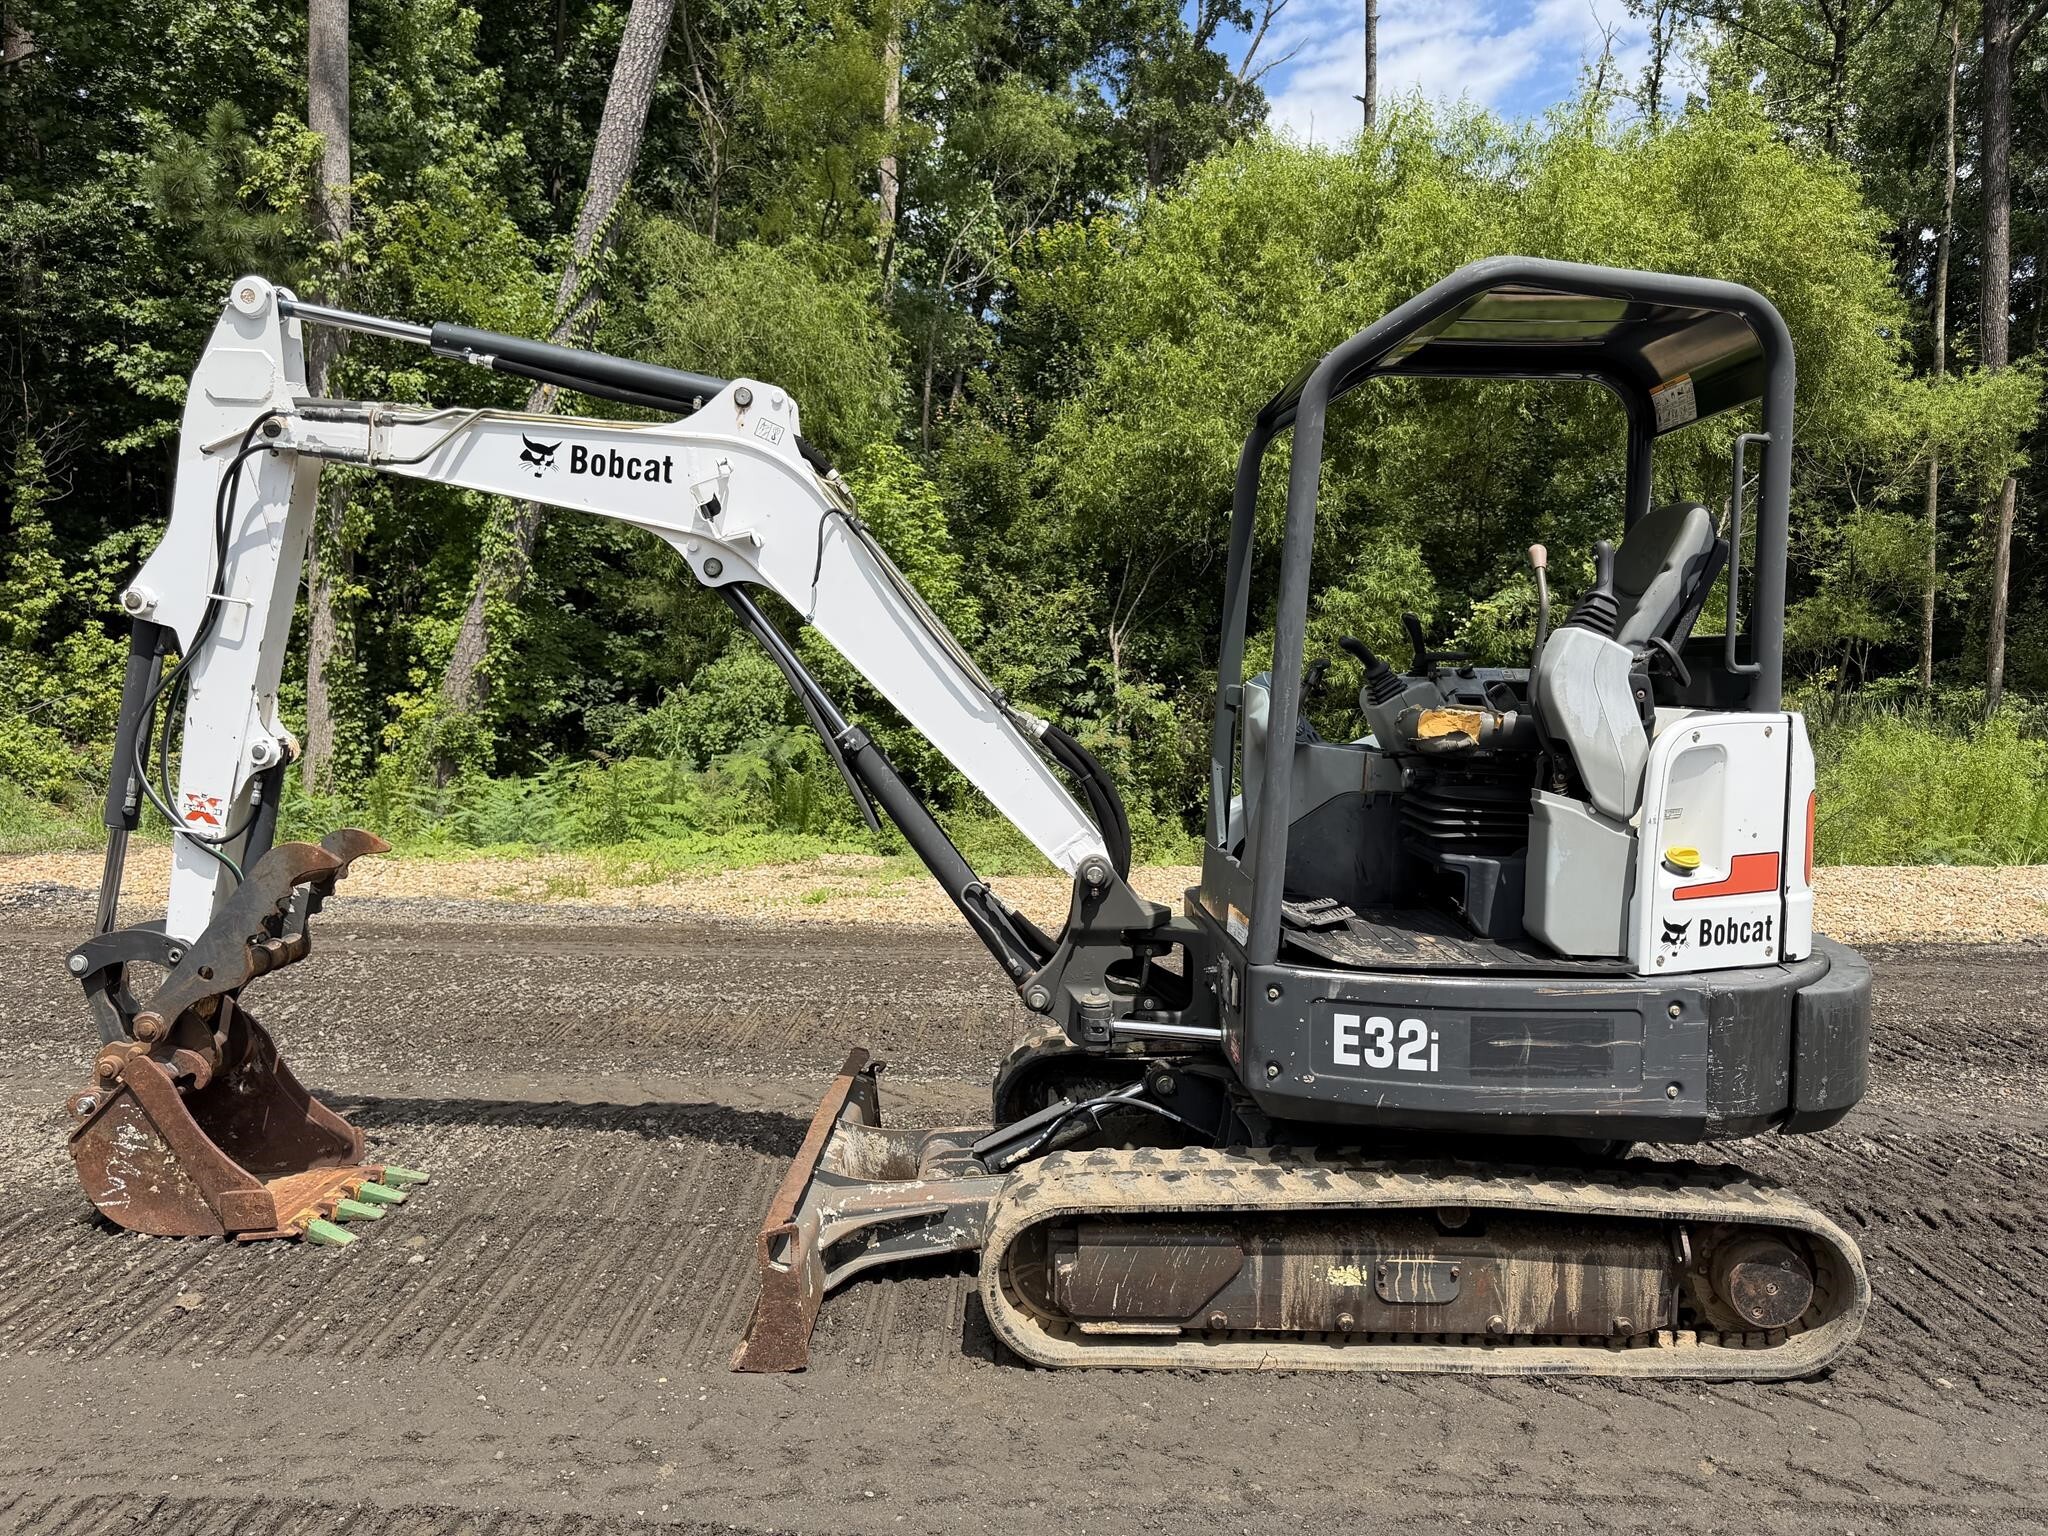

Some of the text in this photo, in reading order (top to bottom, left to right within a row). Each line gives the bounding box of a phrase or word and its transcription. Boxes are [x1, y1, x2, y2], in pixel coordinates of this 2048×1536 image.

[570, 444, 674, 484] Bobcat
[1699, 915, 1773, 947] Bobcat
[1333, 1013, 1439, 1072] E32i
